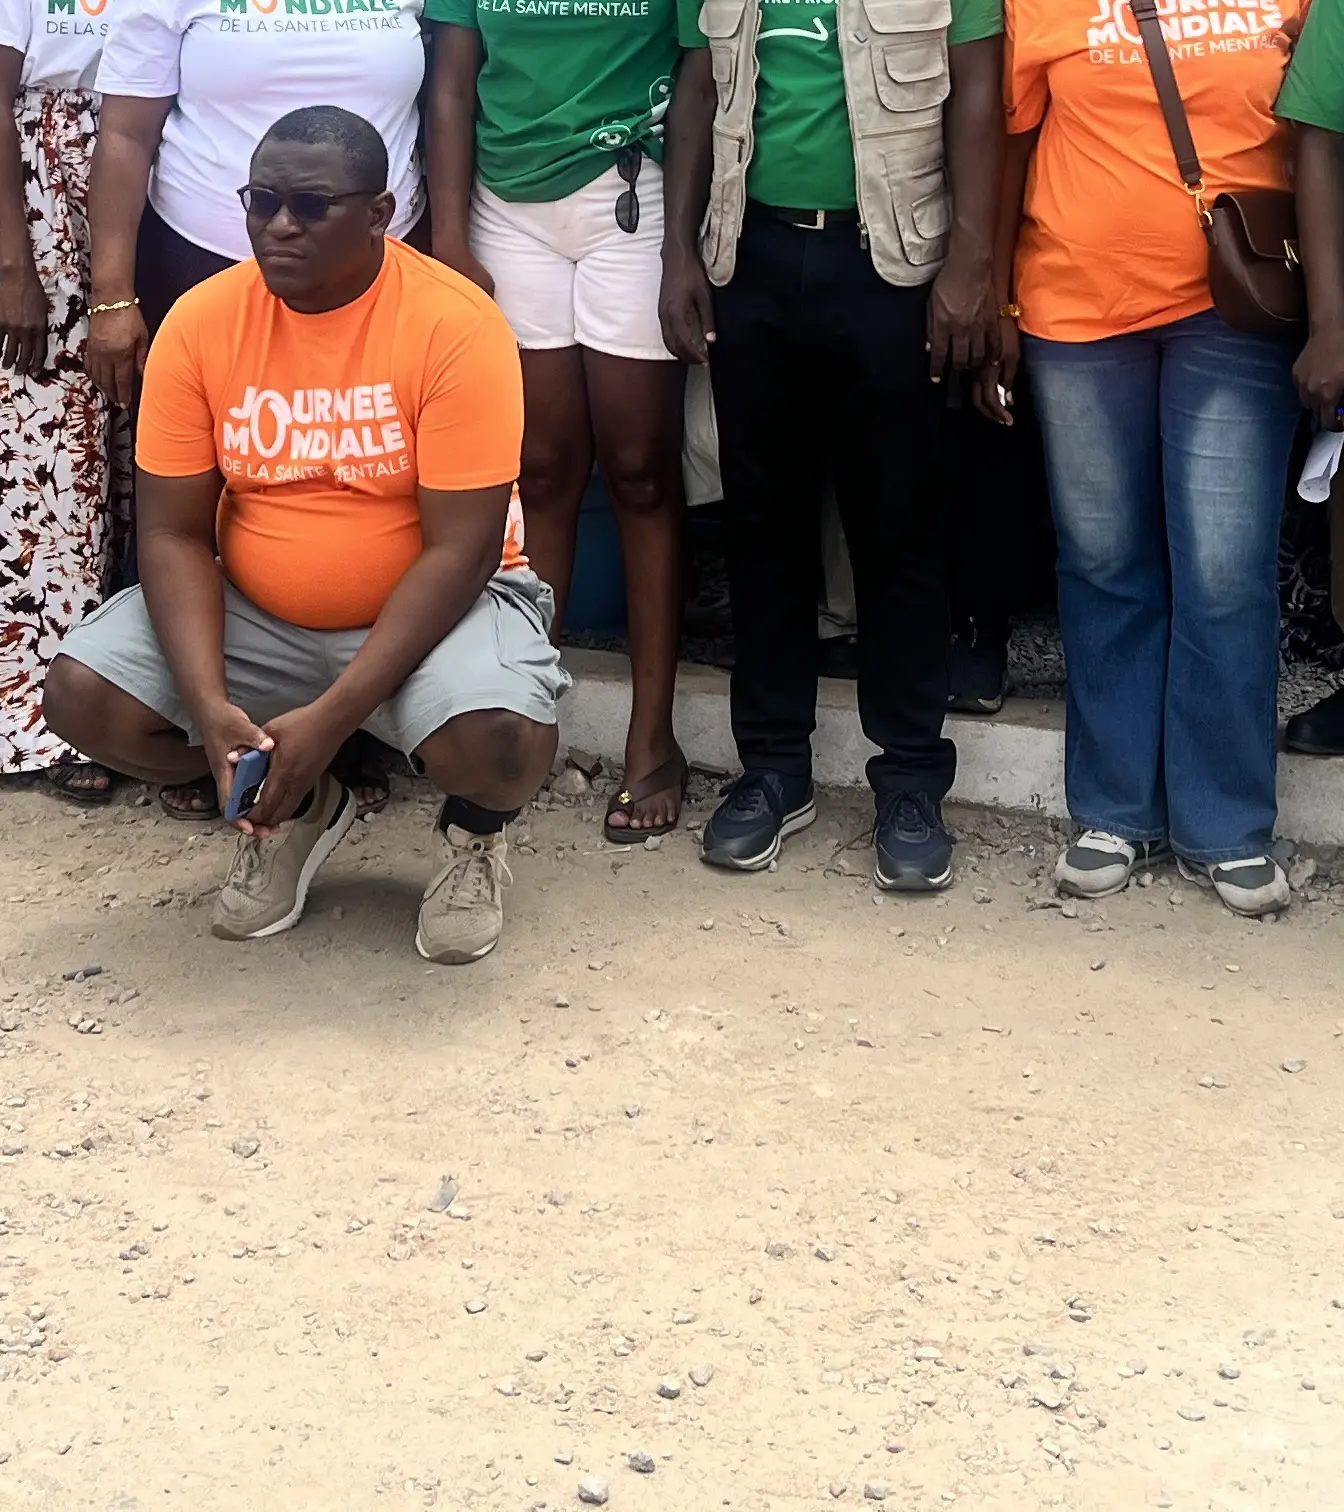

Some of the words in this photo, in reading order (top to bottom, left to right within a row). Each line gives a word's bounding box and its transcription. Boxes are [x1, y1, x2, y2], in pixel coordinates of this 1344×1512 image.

[493, 0, 511, 13] LA
[516, 0, 569, 16] SANTE
[574, 1, 649, 17] MENTALE
[46, 21, 68, 34] DE
[74, 22, 94, 36] LA
[220, 18, 241, 32] DE
[247, 19, 267, 33] LA
[274, 19, 329, 33] SANTE
[334, 16, 404, 32] MENTALE
[1090, 49, 1114, 64] DE
[1120, 51, 1143, 64] LA
[1169, 42, 1205, 61] NTE
[228, 382, 398, 424] JOURNEE
[223, 421, 406, 460] MONDIALE
[223, 456, 241, 476] DE
[247, 463, 269, 480] LA
[274, 464, 326, 482] SANTE
